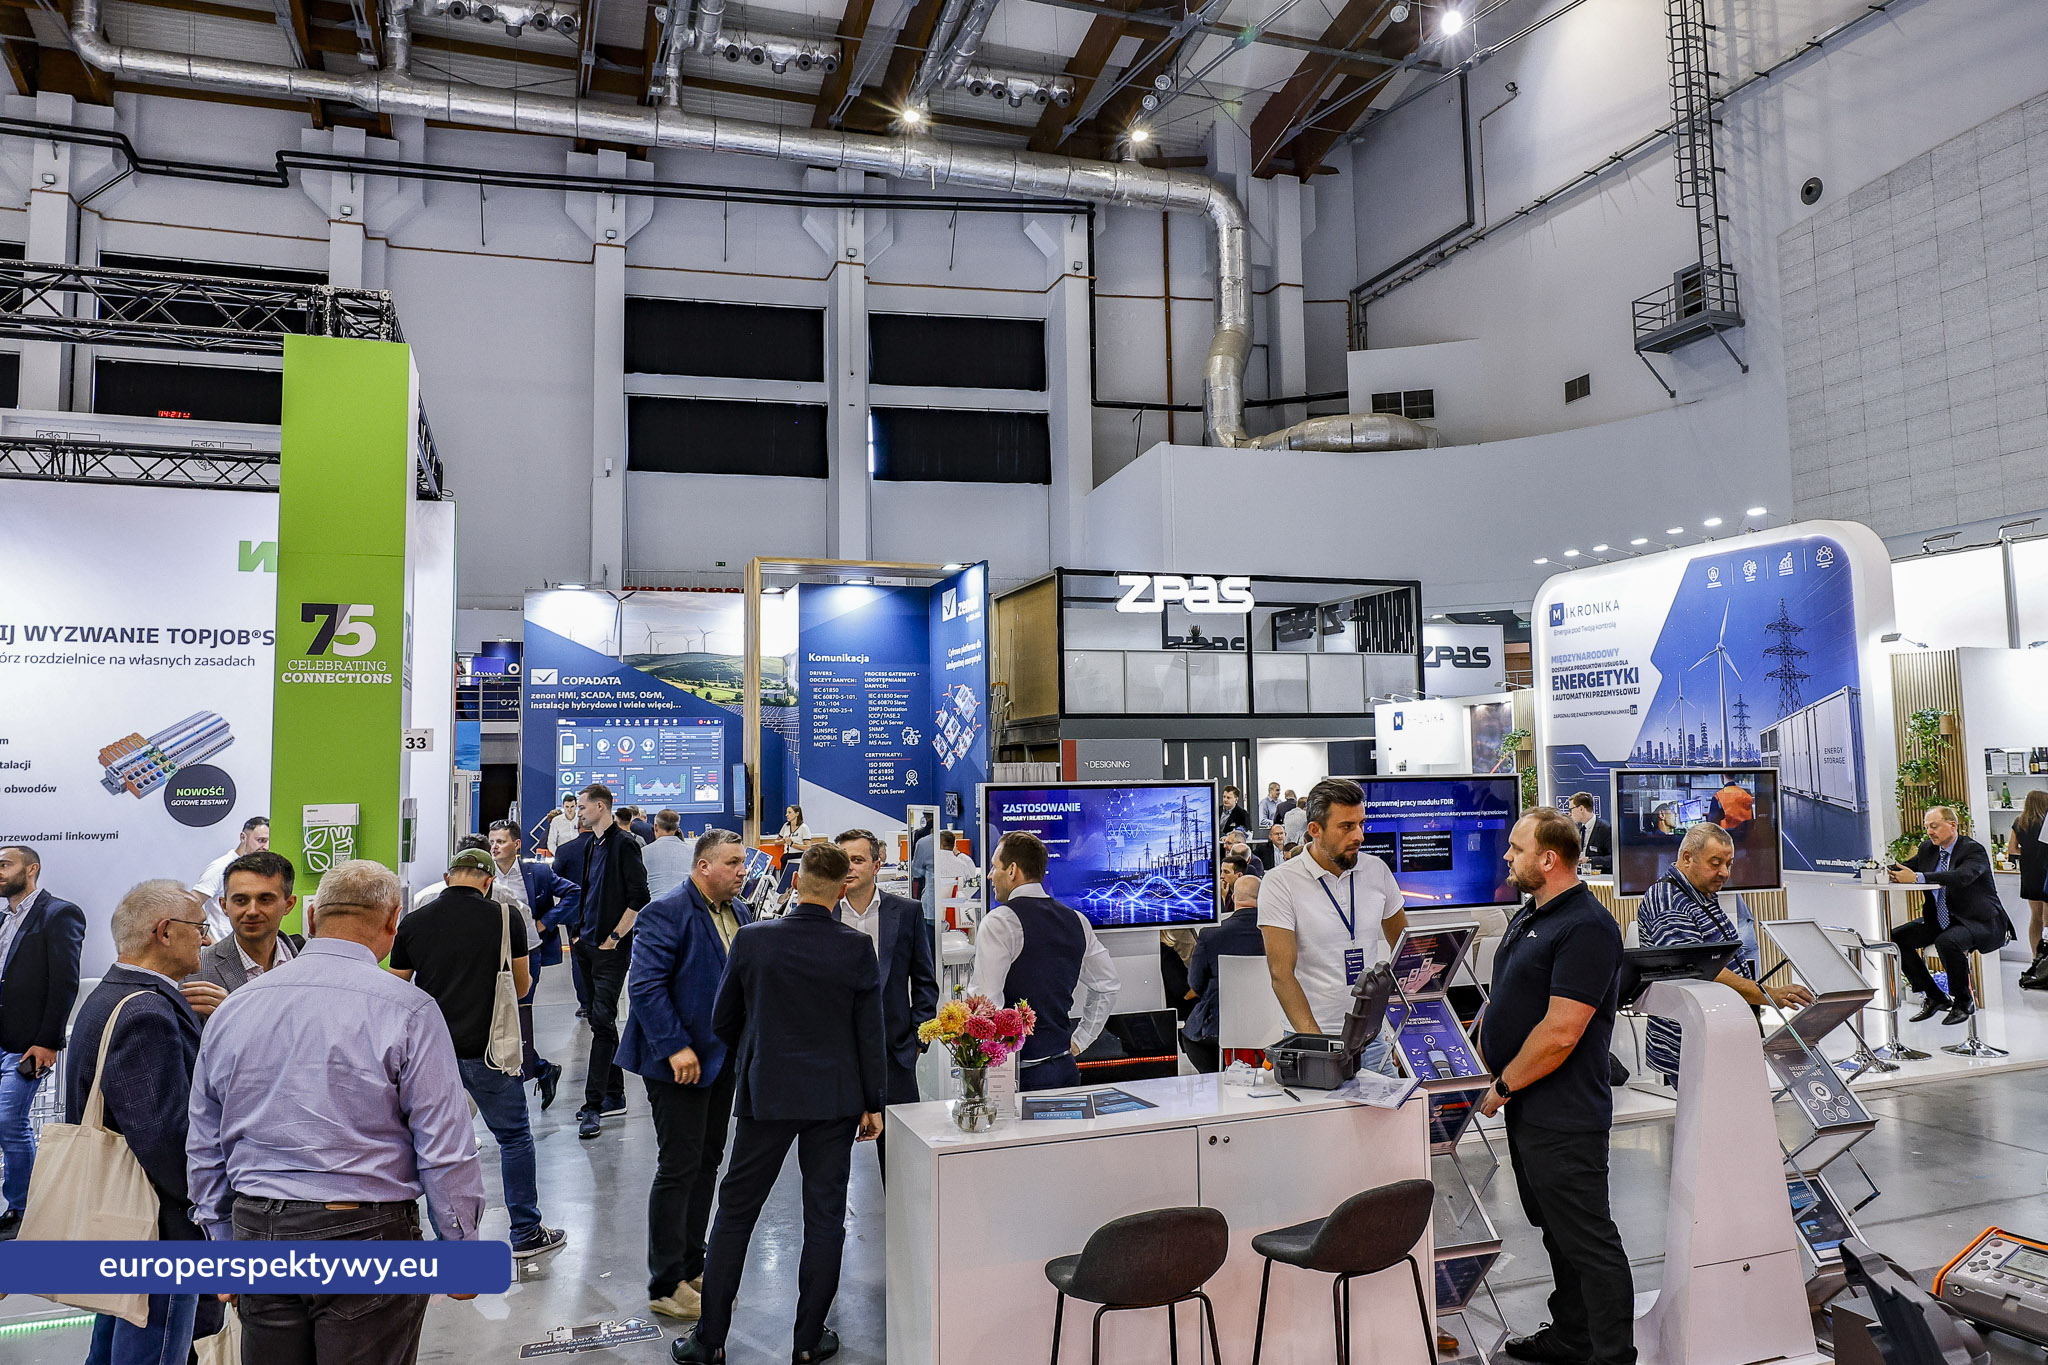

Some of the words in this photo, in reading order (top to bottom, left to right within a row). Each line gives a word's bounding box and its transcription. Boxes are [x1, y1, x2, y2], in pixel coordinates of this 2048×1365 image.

[24, 625, 159, 643] WYZWANIE
[301, 603, 377, 657] 75
[24, 653, 105, 665] rozdzielnice
[109, 656, 125, 665] na
[129, 654, 191, 668] własnych
[195, 656, 255, 667] zasadach
[808, 653, 870, 664] Komunikacja
[1551, 648, 1619, 665] MIĘDZYNARODOWY
[288, 660, 387, 672] CELEBRATING
[281, 673, 392, 684] CONNECTIONS
[1552, 667, 1640, 691] ENERGETYKI
[558, 692, 579, 701] HMI,
[581, 692, 614, 701] SCADA,
[616, 692, 638, 701] EMS,
[639, 692, 665, 701] O&M,
[1555, 691, 1592, 700] AUTOMATYKI
[1592, 687, 1640, 698] PRZEMYSŁOWEJ
[530, 702, 570, 711] instalacje
[571, 702, 618, 711] hybrydowe
[405, 737, 427, 750] 33
[1824, 747, 1843, 755] ENERGY
[1089, 760, 1131, 769] DESIGNING
[1823, 757, 1846, 765] STORAGE
[4, 784, 57, 794] obwodów
[176, 786, 225, 796] NOWOŚĆ!
[1002, 802, 1081, 814] ZASTOSOWANIE
[1367, 800, 1400, 808] poprawnej
[1400, 799, 1416, 807] pracy
[65, 831, 119, 842] linkowymi
